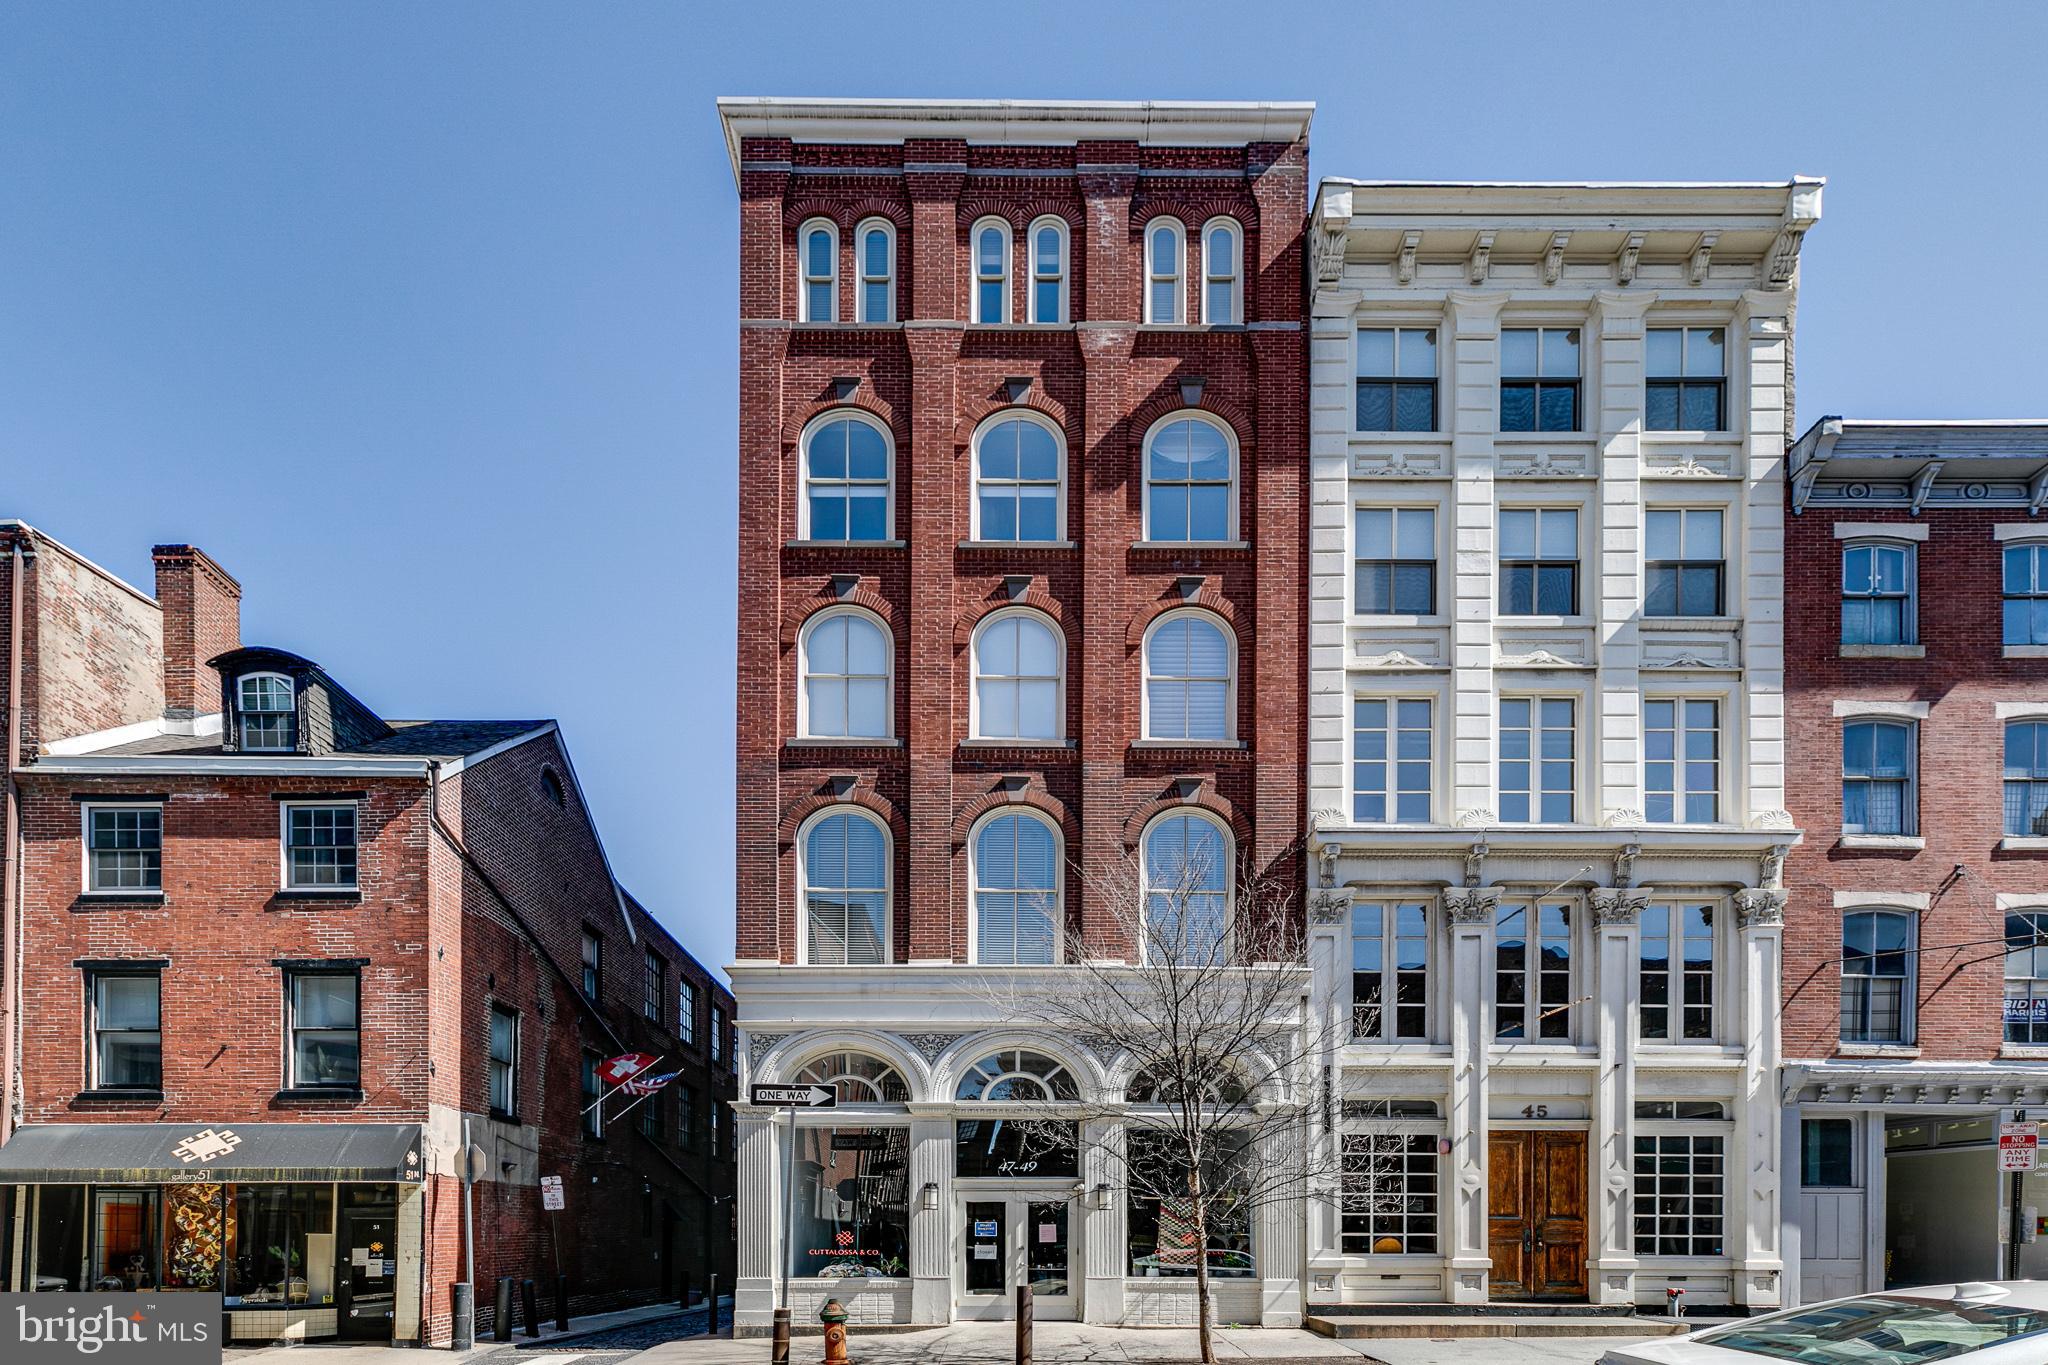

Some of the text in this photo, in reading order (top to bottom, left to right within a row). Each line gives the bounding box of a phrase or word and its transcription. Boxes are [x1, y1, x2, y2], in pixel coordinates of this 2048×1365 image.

[760, 1091, 811, 1100] ONE WAY
[1521, 1104, 1548, 1118] 45
[998, 1161, 1038, 1171] 47-49
[405, 1169, 414, 1180] 51
